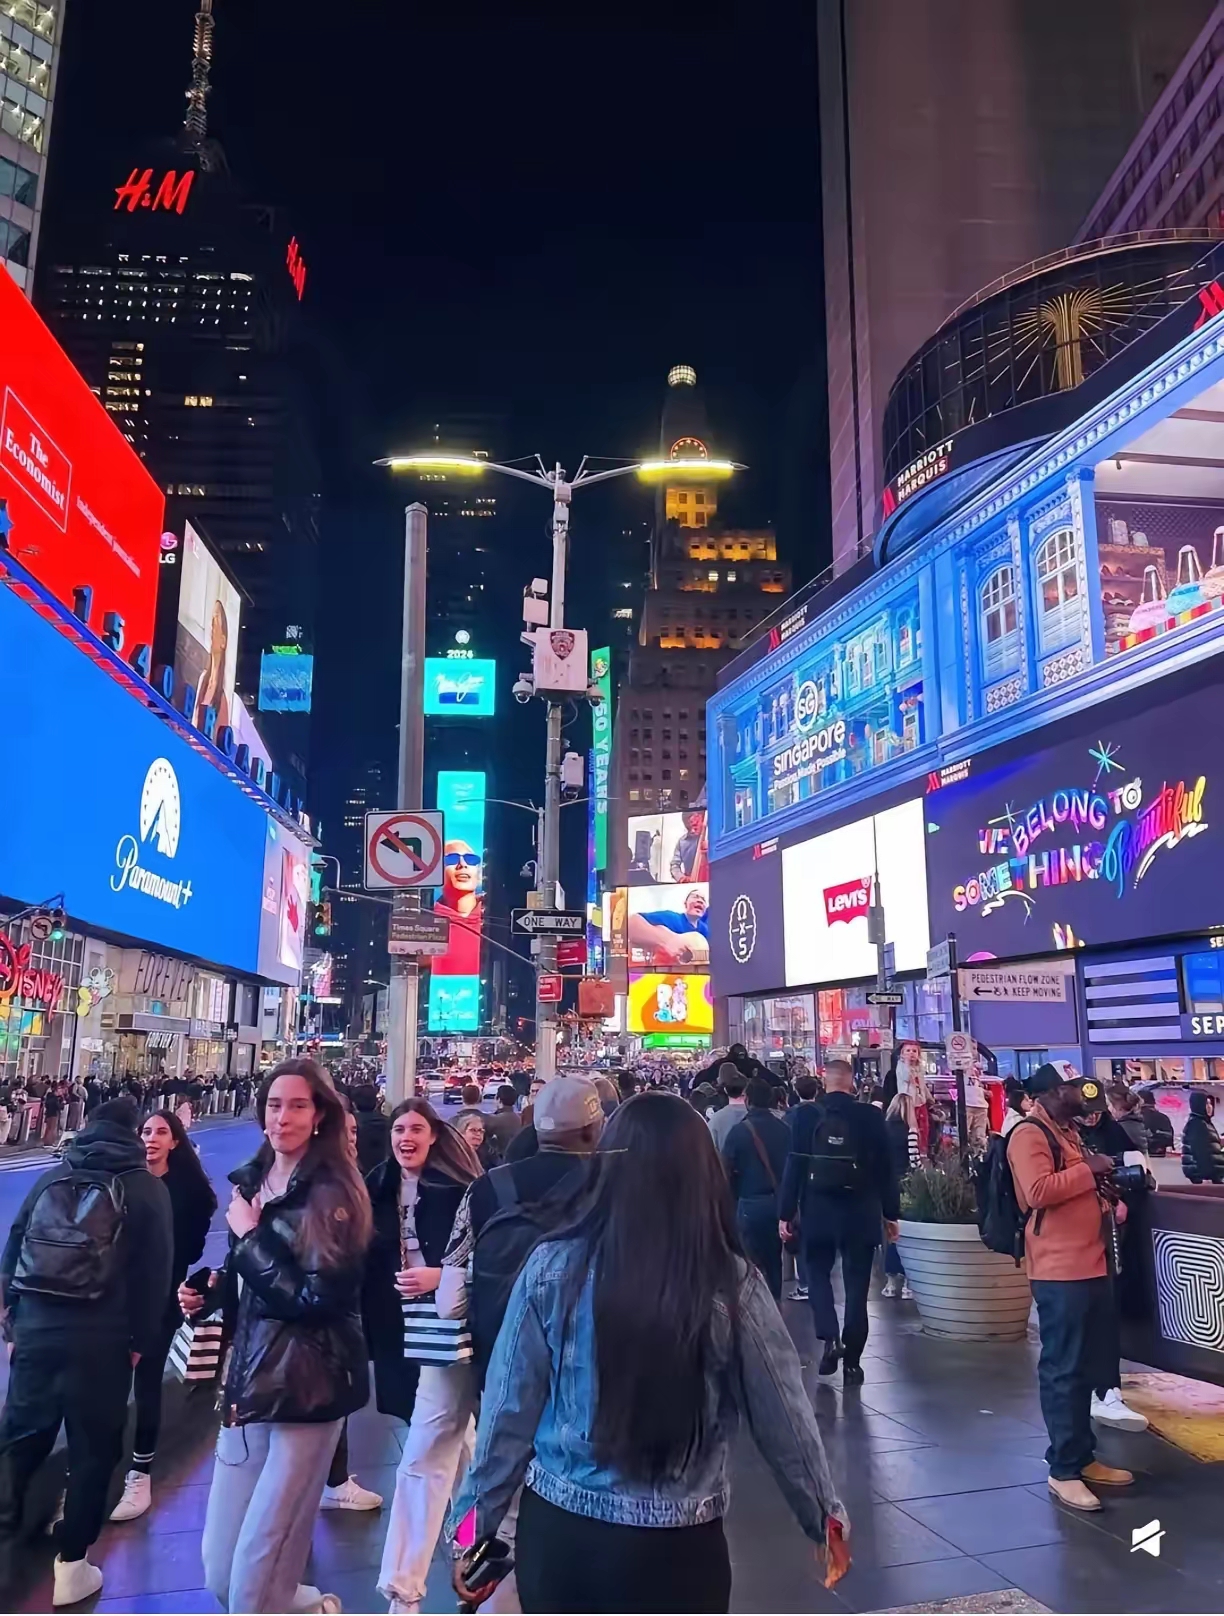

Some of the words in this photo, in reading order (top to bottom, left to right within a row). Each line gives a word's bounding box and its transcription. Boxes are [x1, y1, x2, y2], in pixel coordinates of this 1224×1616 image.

[114, 167, 195, 215] H&M
[5, 428, 65, 510] Economist
[30, 432, 49, 468] The
[897, 440, 954, 487] MARRIOTT
[898, 459, 947, 501] MARQUIS
[158, 552, 176, 564] LG
[594, 738, 610, 815] YEARS
[941, 758, 972, 777] MARRIOTT
[941, 769, 969, 787] MARQUIS
[978, 828, 1010, 854] WE
[1012, 789, 1108, 855] BELONG
[953, 840, 1104, 912] SOMETHING
[1101, 775, 1207, 899] Beautiful
[110, 834, 193, 909] Paramount+
[392, 923, 414, 932] Times
[414, 924, 440, 933] Square
[523, 916, 545, 927] ONE
[554, 917, 578, 927] WAY
[134, 950, 198, 1002] FOREVER
[971, 973, 1018, 985] PEDESTRIAN
[1019, 974, 1039, 985] FLOW
[1040, 975, 1060, 986] ZONE
[1012, 987, 1031, 997] KEEP
[1032, 986, 1062, 998] MOVING
